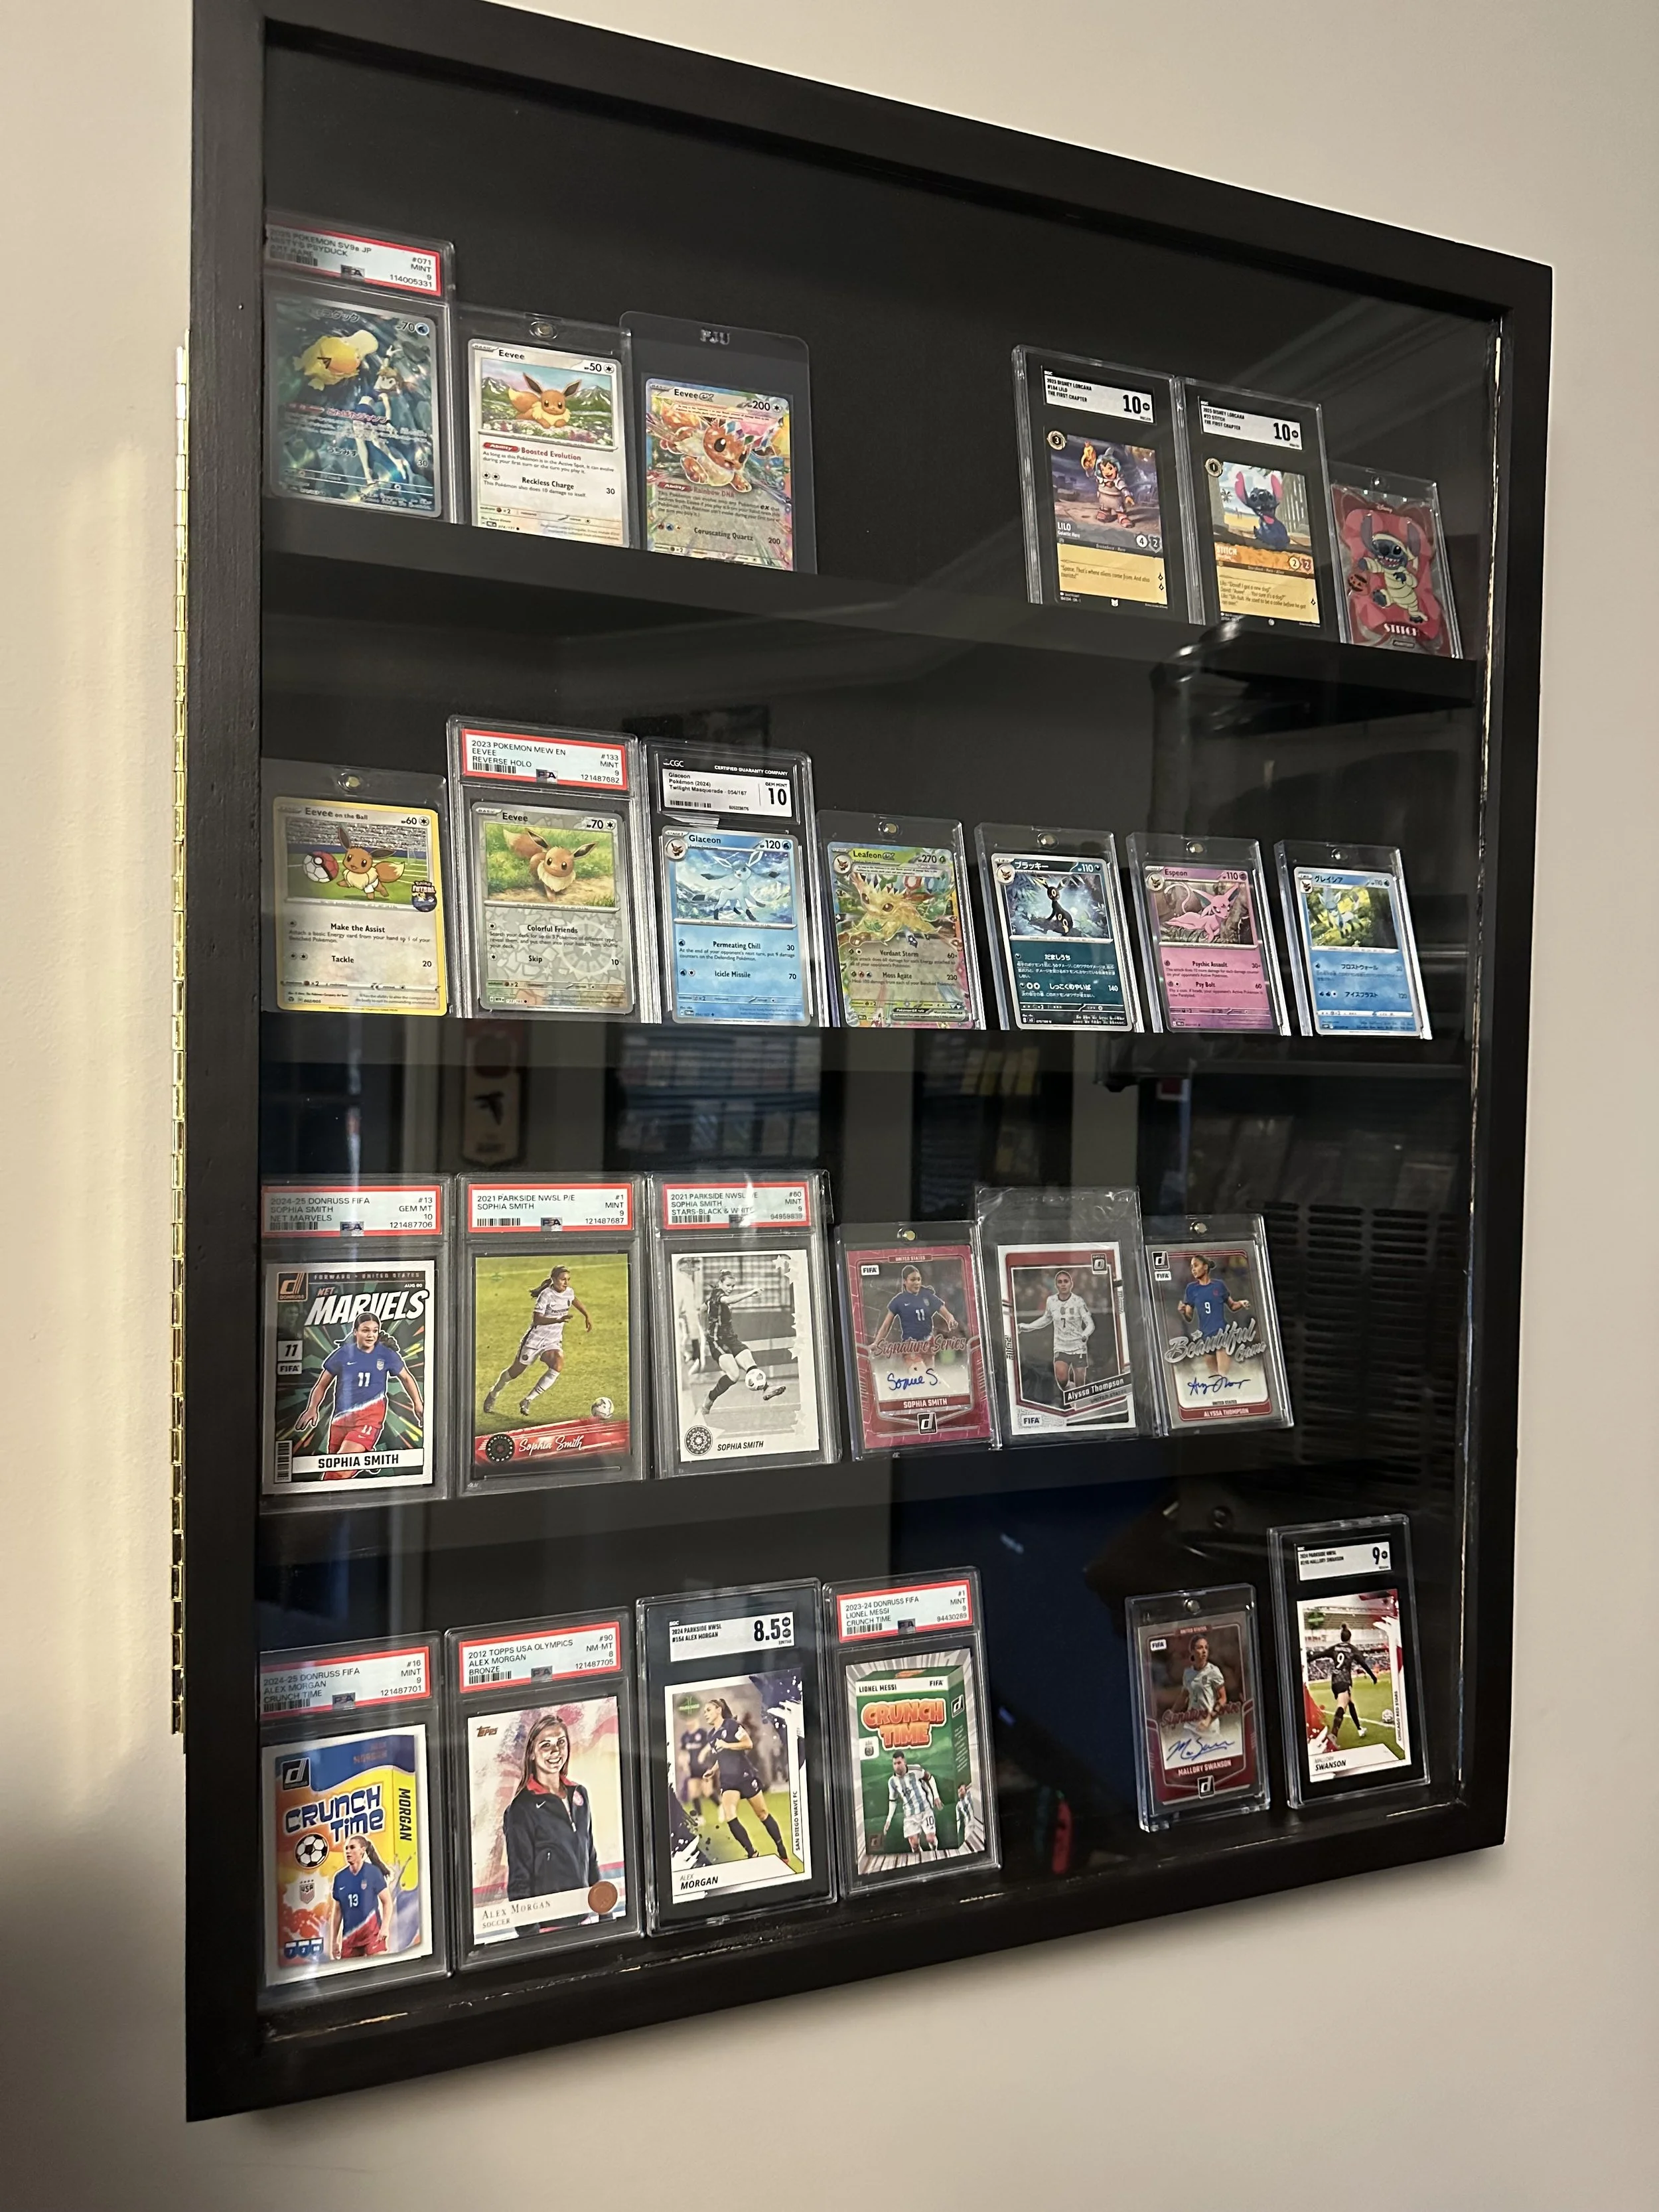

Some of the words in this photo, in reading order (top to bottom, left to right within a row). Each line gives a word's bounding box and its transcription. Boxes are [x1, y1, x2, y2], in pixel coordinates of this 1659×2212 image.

[307, 244, 348, 256] PSYDUCK
[390, 274, 432, 287] 114005331
[498, 350, 525, 360] Eevee
[1123, 395, 1141, 414] 10
[1273, 423, 1290, 441] 10
[522, 447, 548, 456] Boosted
[550, 451, 581, 461] Evolution
[522, 477, 549, 486] Reckless
[551, 480, 574, 490] Charge
[694, 527, 731, 540] Coruscating
[732, 532, 753, 541] Quartz
[1216, 546, 1237, 555] STITCH
[493, 743, 532, 752] POKEMON
[473, 756, 508, 765] REVERSE
[768, 788, 787, 805] 10
[502, 812, 528, 822] Eevee
[689, 835, 721, 844] Glaceon
[765, 840, 780, 849] 120
[713, 941, 746, 950] Permeating
[318, 1287, 334, 1296] NET
[304, 1290, 429, 1326] MARVELS
[916, 1309, 925, 1321] 11
[875, 1337, 930, 1357] Signature
[932, 1334, 966, 1352] Series
[1165, 1318, 1256, 1363] Beautiful
[285, 1344, 298, 1357] 11
[1234, 1342, 1266, 1362] Game
[358, 1372, 370, 1386] 11
[1067, 1389, 1090, 1401] Alyssa
[1091, 1379, 1123, 1392] Thompson
[519, 1438, 552, 1455] Sophia
[555, 1435, 584, 1451] Smith
[717, 1442, 741, 1451] SOPHIA
[318, 1457, 360, 1469] SOPHIA
[364, 1454, 399, 1466] SMITH
[937, 1613, 967, 1621] 94430289
[754, 1618, 780, 1641] 8.5
[489, 1647, 514, 1656] TOPPS
[534, 1640, 573, 1651] OLYMPICS
[492, 1655, 526, 1664] MORGAN
[576, 1659, 613, 1668] 121487705
[469, 1666, 500, 1676] BRONZE
[264, 1676, 298, 1686] 2024-25
[300, 1670, 340, 1681] DONRUSS
[289, 1681, 326, 1691] MORGAN
[381, 1685, 421, 1696] 121487701
[265, 1693, 299, 1703] CRUNCH
[863, 1700, 944, 1726] CRUNCH
[476, 1726, 498, 1737] topps
[880, 1722, 930, 1748] TIME
[1178, 1765, 1204, 1776] MALLORY
[1205, 1760, 1231, 1771] SWANSON
[1315, 1761, 1346, 1771] SWANSON
[285, 1785, 381, 1833] CRUNCH
[399, 1788, 411, 1841] MORGAN
[681, 1876, 718, 1889] MORGAN
[348, 1894, 358, 1907] 13
[482, 1908, 506, 1920] ALEX
[511, 1901, 551, 1914] MORGAN
[482, 1918, 510, 1928] SOCCER
